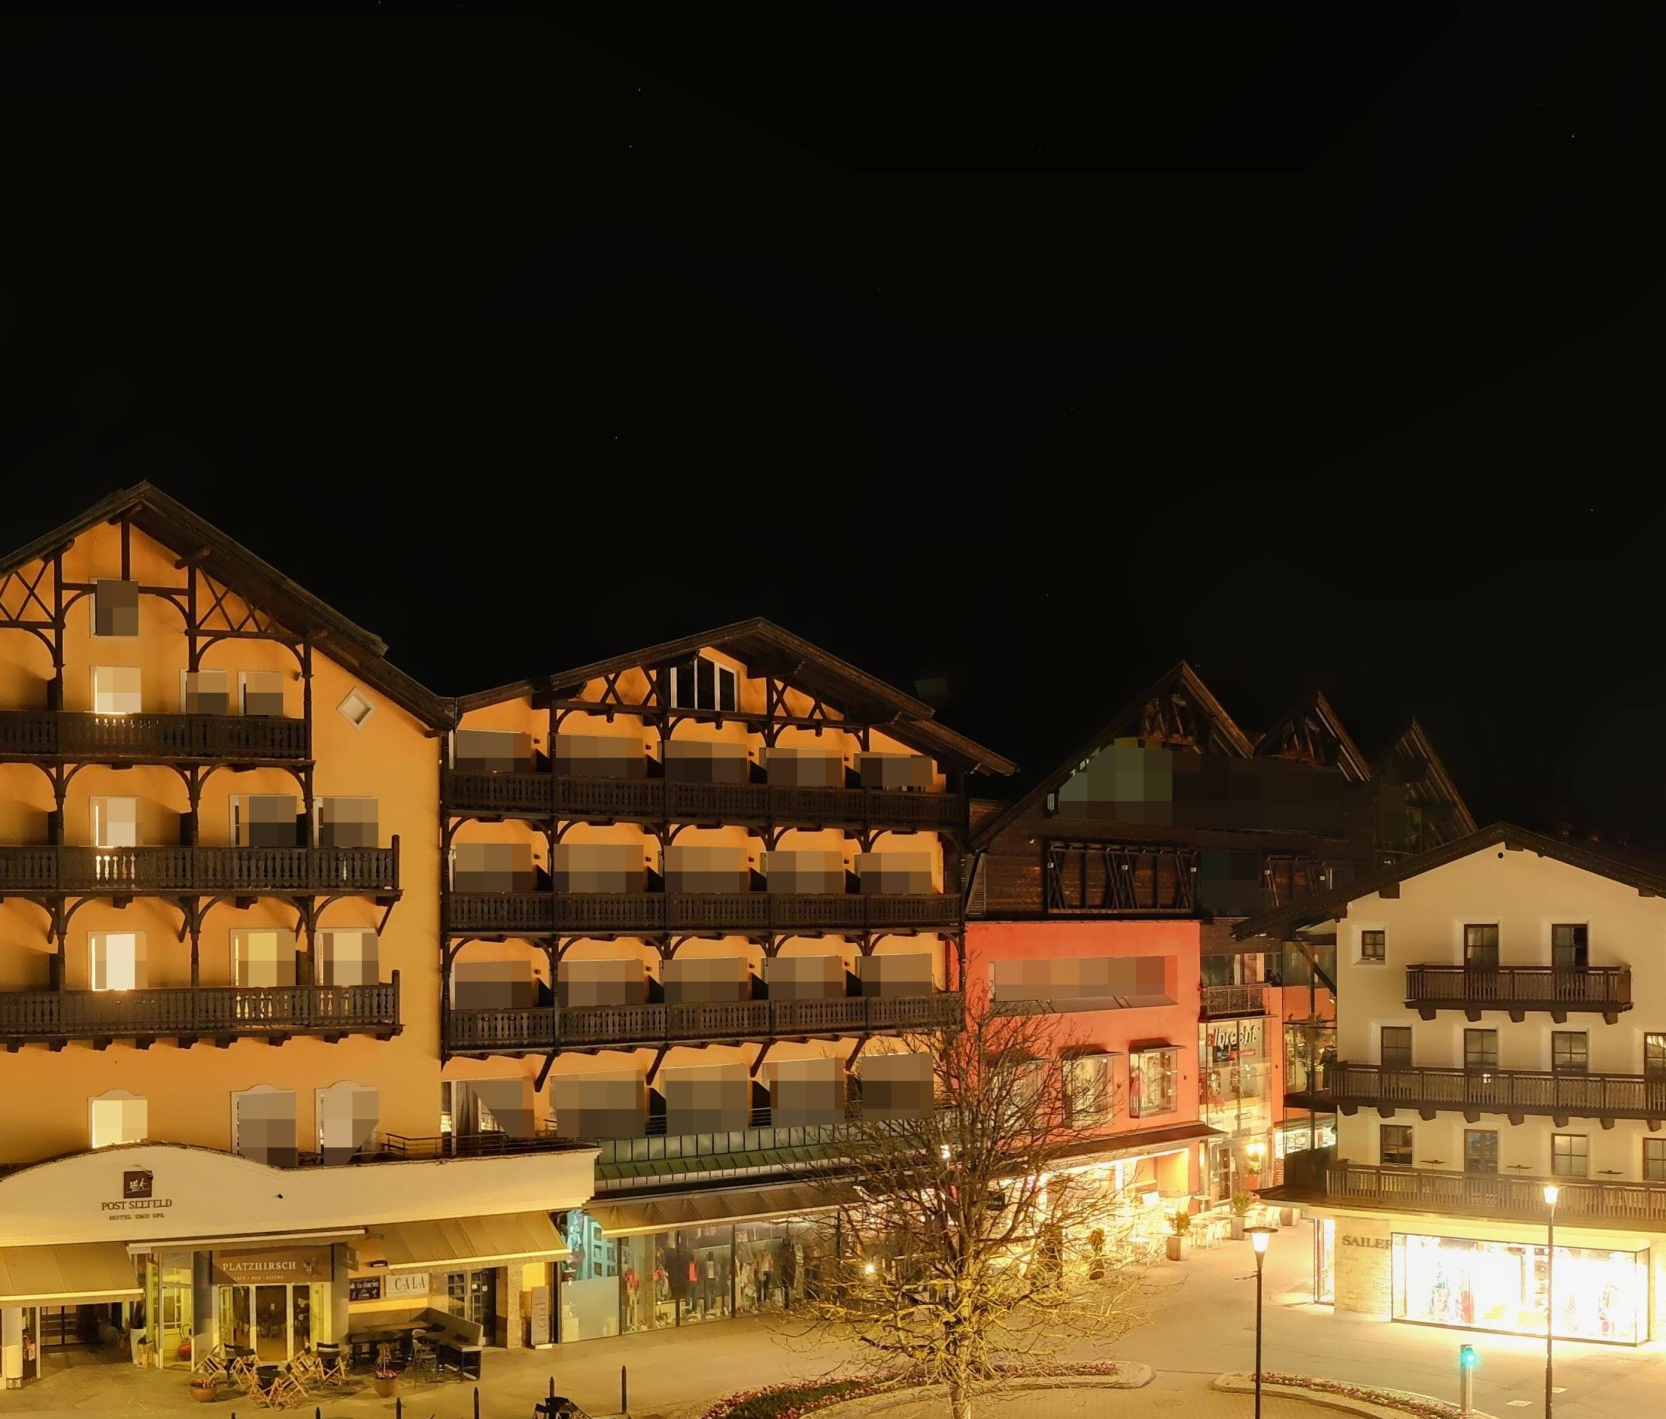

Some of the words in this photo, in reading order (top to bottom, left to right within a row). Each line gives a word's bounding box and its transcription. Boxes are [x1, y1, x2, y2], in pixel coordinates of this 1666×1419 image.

[101, 1201, 126, 1211] POST
[129, 1199, 172, 1210] SEEFELD
[222, 1261, 296, 1272] PLATZHIRSCH
